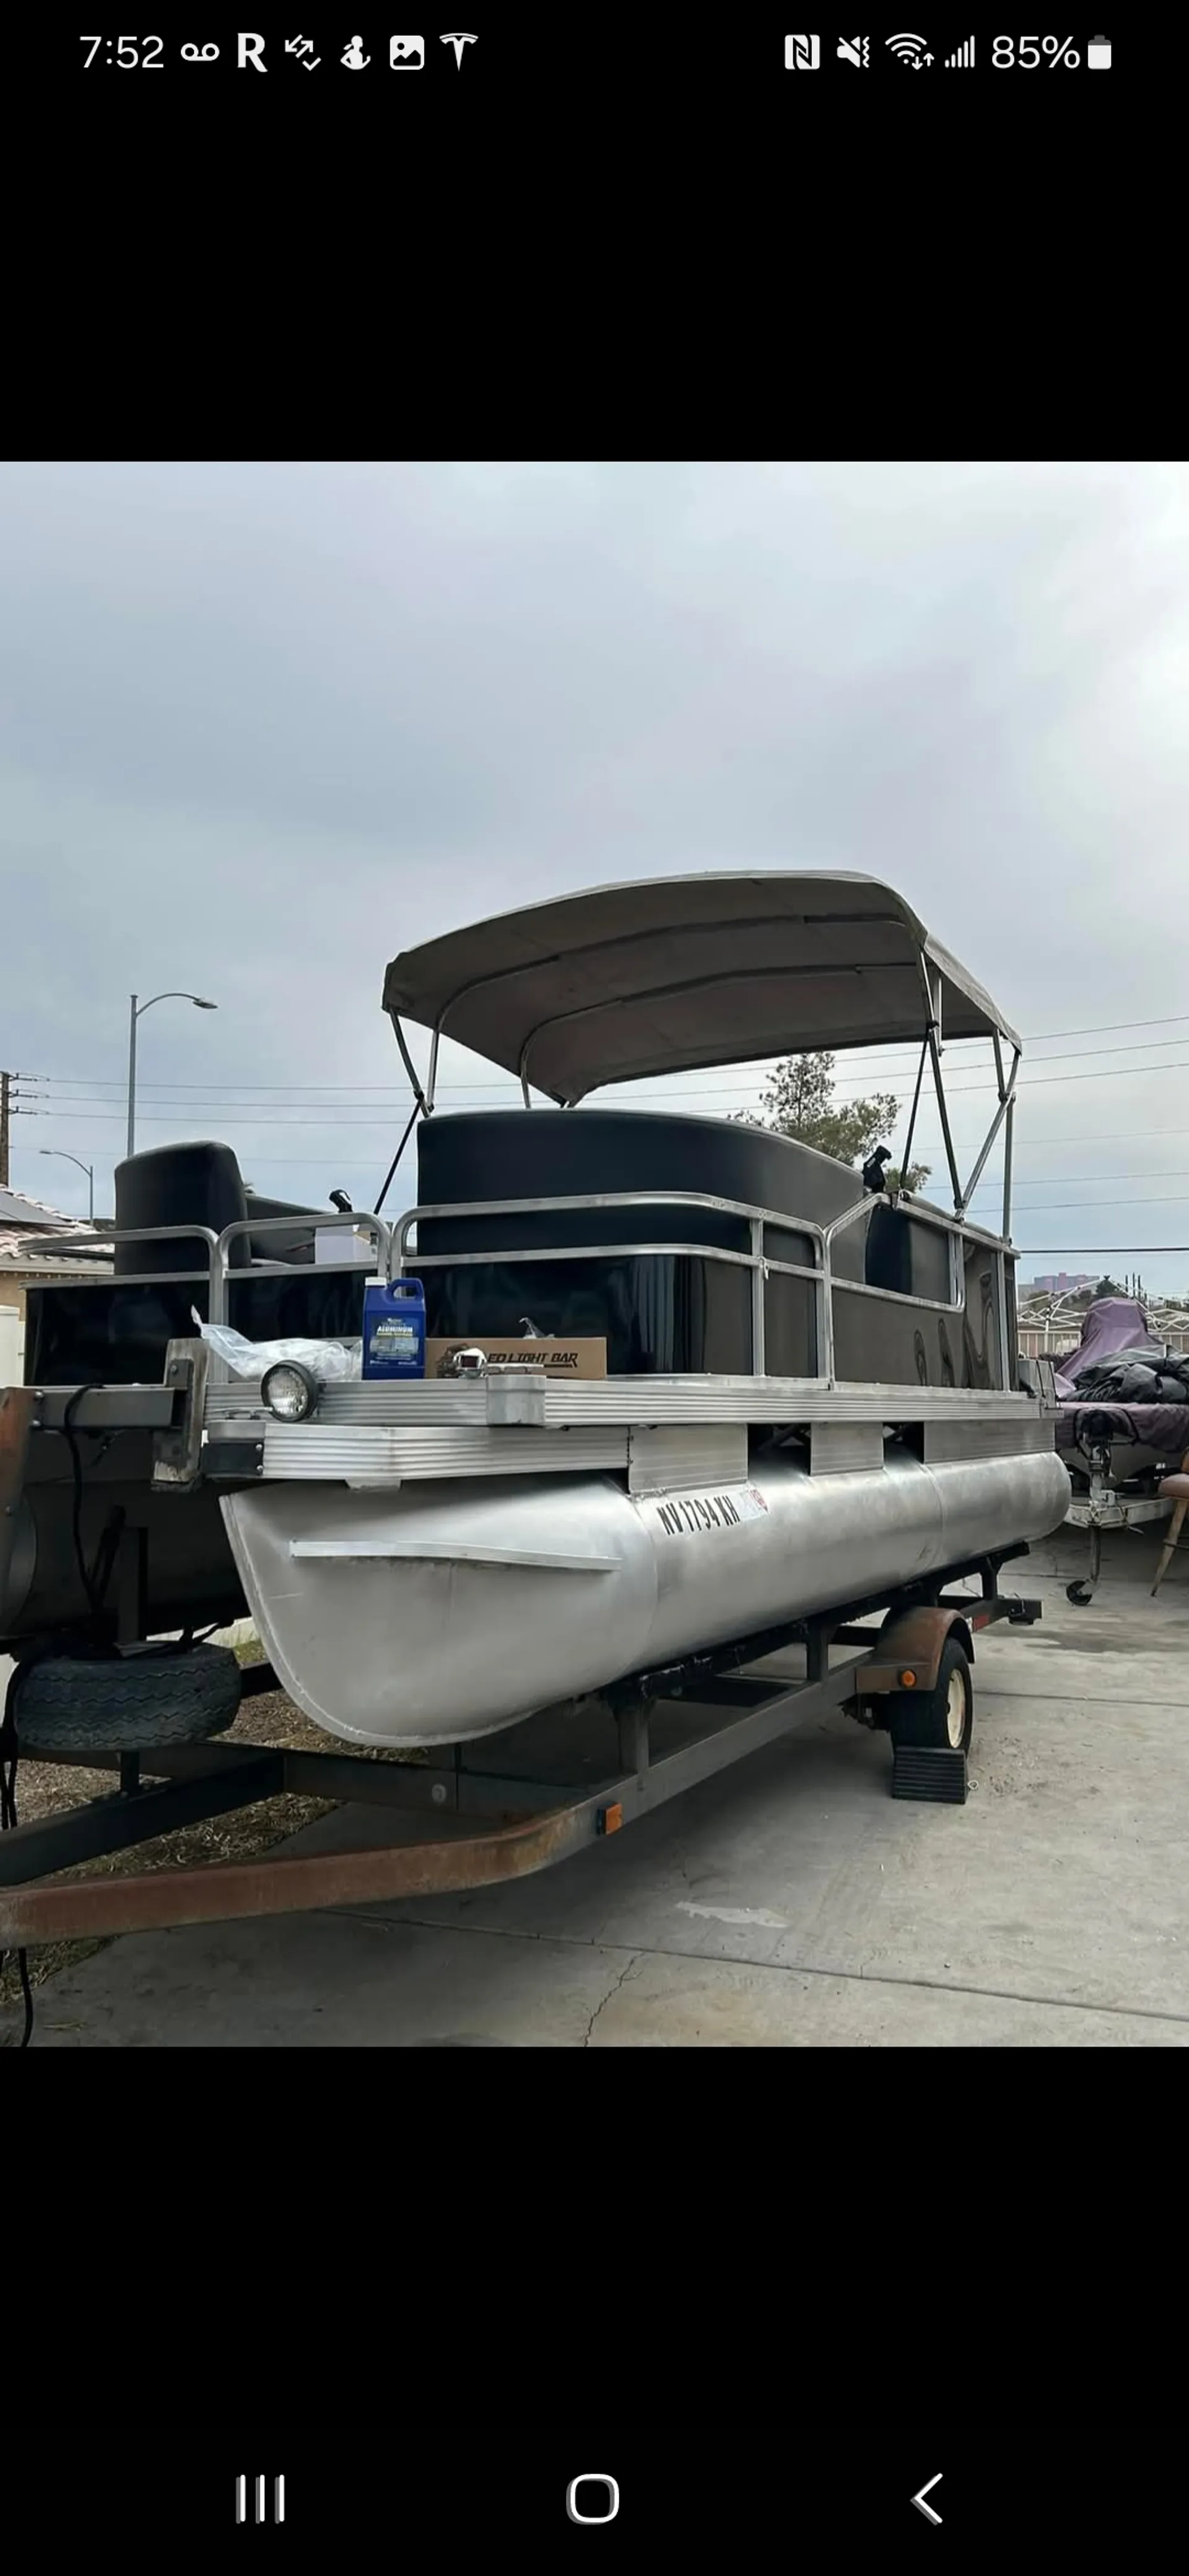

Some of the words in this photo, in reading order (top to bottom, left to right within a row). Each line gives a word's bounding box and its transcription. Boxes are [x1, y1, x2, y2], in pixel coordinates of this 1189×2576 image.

[487, 1352, 507, 1363] ED
[507, 1352, 549, 1363] LIGHT
[551, 1352, 578, 1368] BAR
[656, 1502, 684, 1536] NV
[678, 1499, 721, 1533] 1794
